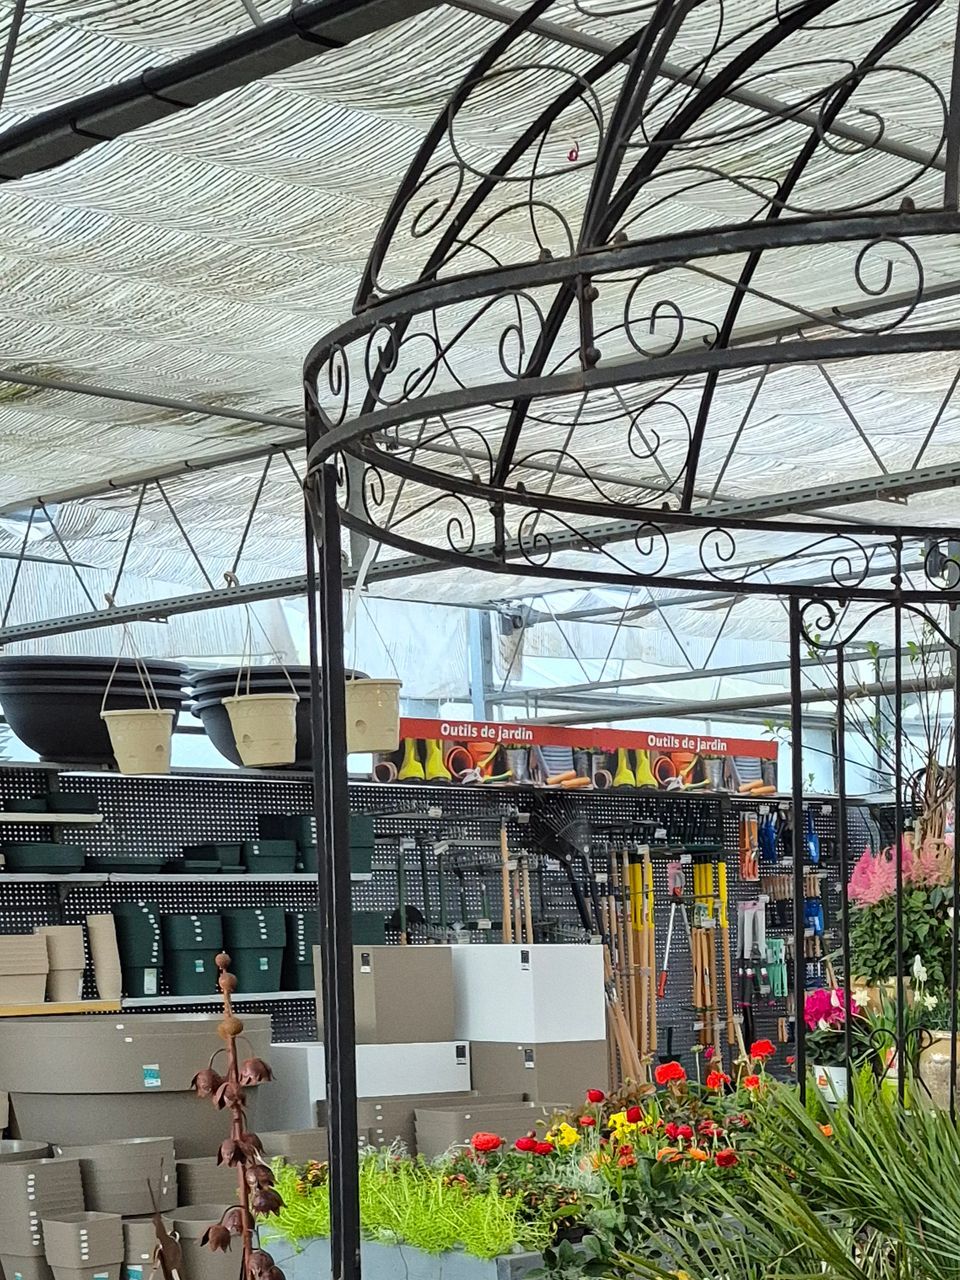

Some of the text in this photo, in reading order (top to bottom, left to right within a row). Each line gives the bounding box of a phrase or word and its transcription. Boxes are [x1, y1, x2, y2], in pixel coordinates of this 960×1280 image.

[440, 723, 533, 742] Outils de jardin
[647, 734, 727, 752] Outils de jardin
